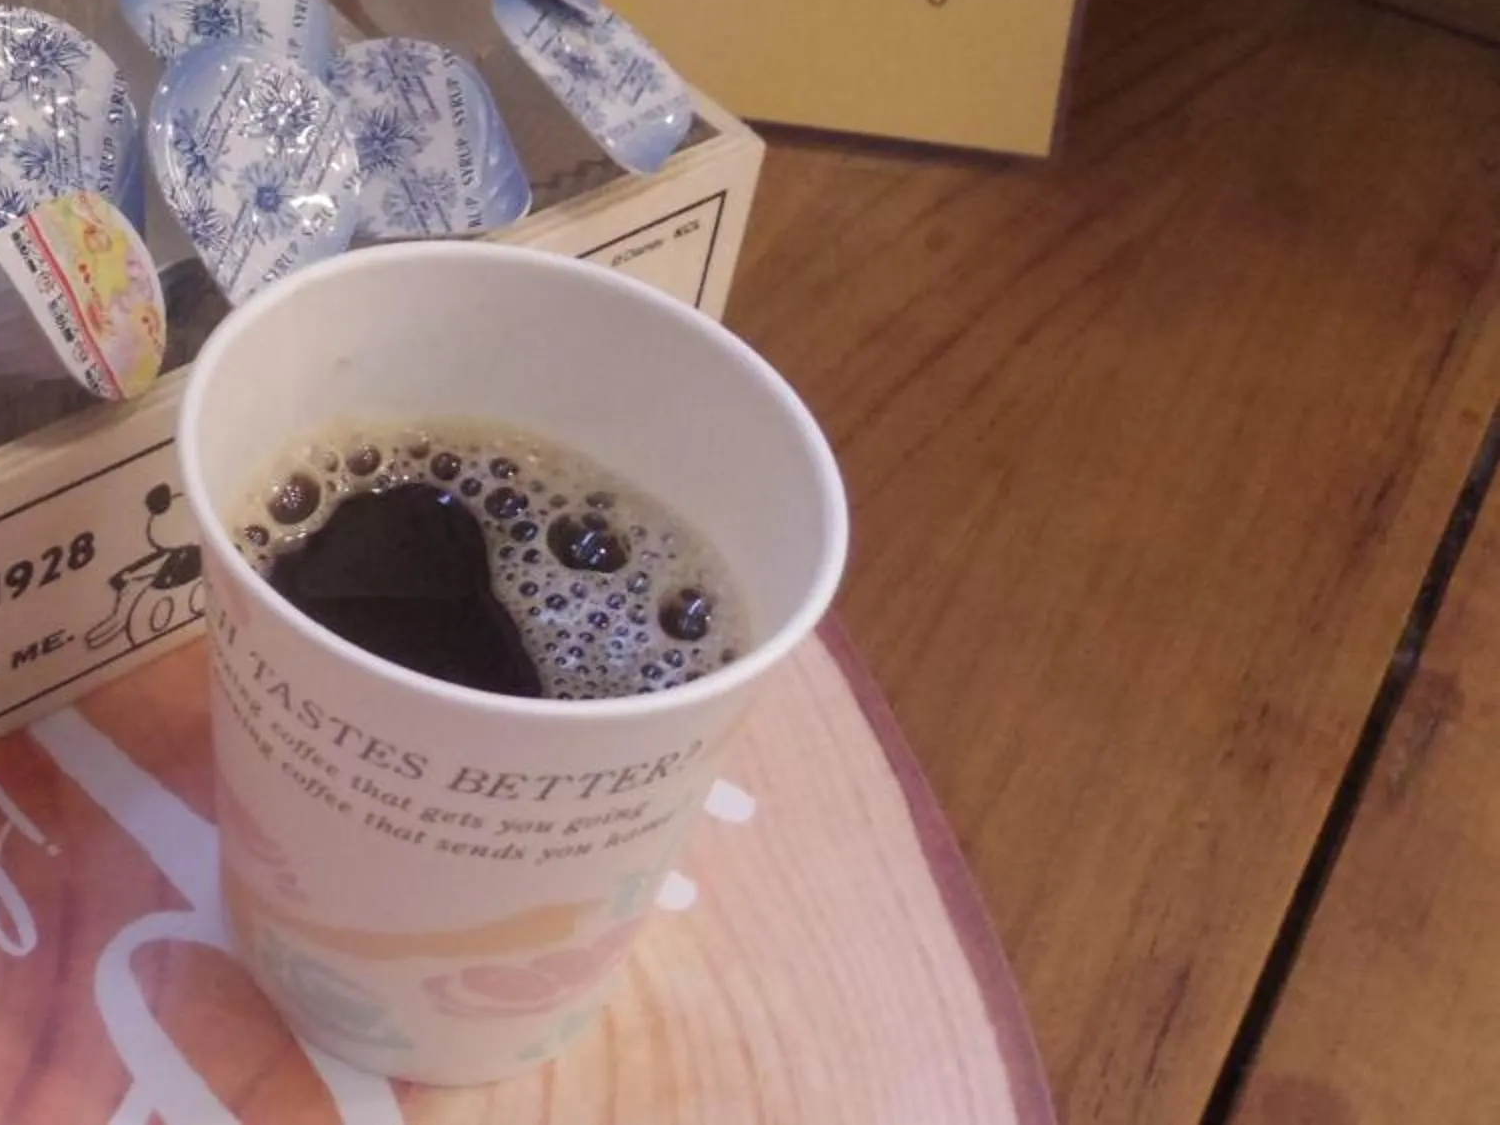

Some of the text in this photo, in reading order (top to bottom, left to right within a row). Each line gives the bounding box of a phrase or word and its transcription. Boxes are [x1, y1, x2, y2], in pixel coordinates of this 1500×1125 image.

[11, 628, 76, 670] ME.
[249, 650, 431, 781] TASTES
[270, 721, 341, 777] coffee
[350, 775, 413, 813] that
[418, 806, 484, 830] gets
[495, 819, 555, 837] you
[281, 760, 354, 814] coffee
[364, 810, 428, 845] that
[435, 838, 527, 861] sends
[533, 842, 594, 866] you
